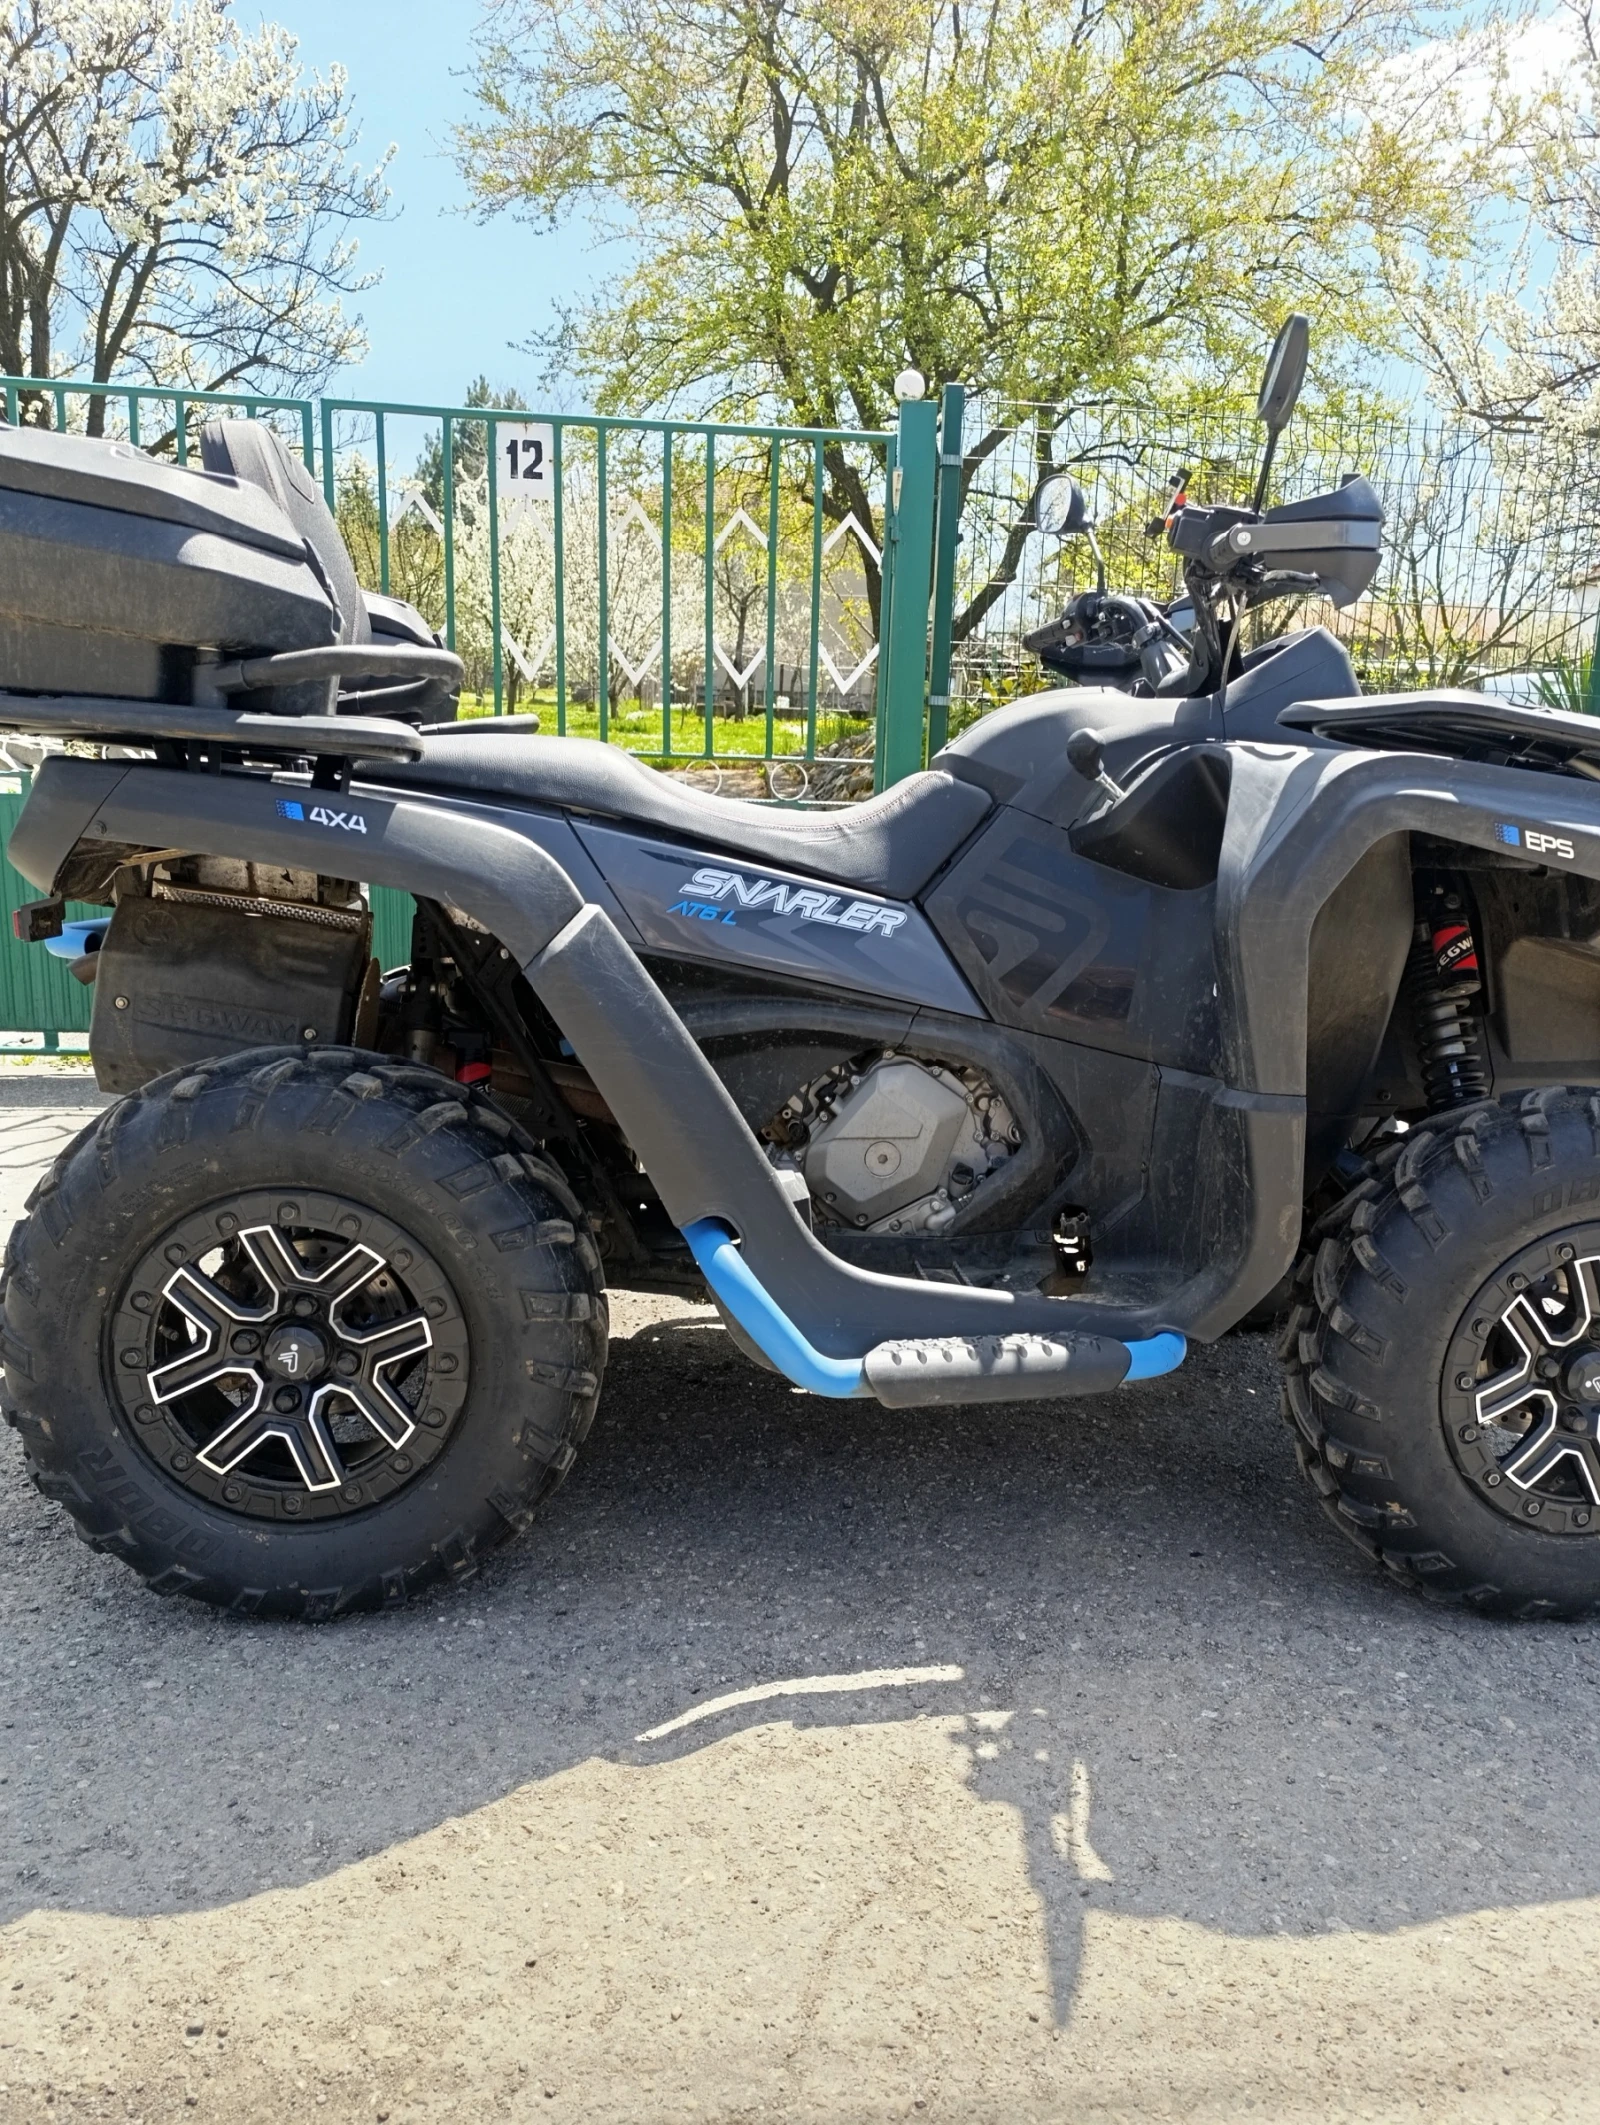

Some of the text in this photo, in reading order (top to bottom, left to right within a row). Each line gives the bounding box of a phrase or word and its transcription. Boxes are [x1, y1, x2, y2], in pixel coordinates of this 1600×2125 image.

[506, 439, 543, 480] 12
[309, 806, 368, 834] 4X4
[1524, 830, 1574, 860] EPS
[679, 868, 907, 937] SNARLER
[136, 995, 297, 1042] SEGWAY
[77, 1446, 226, 1562] OBOR
